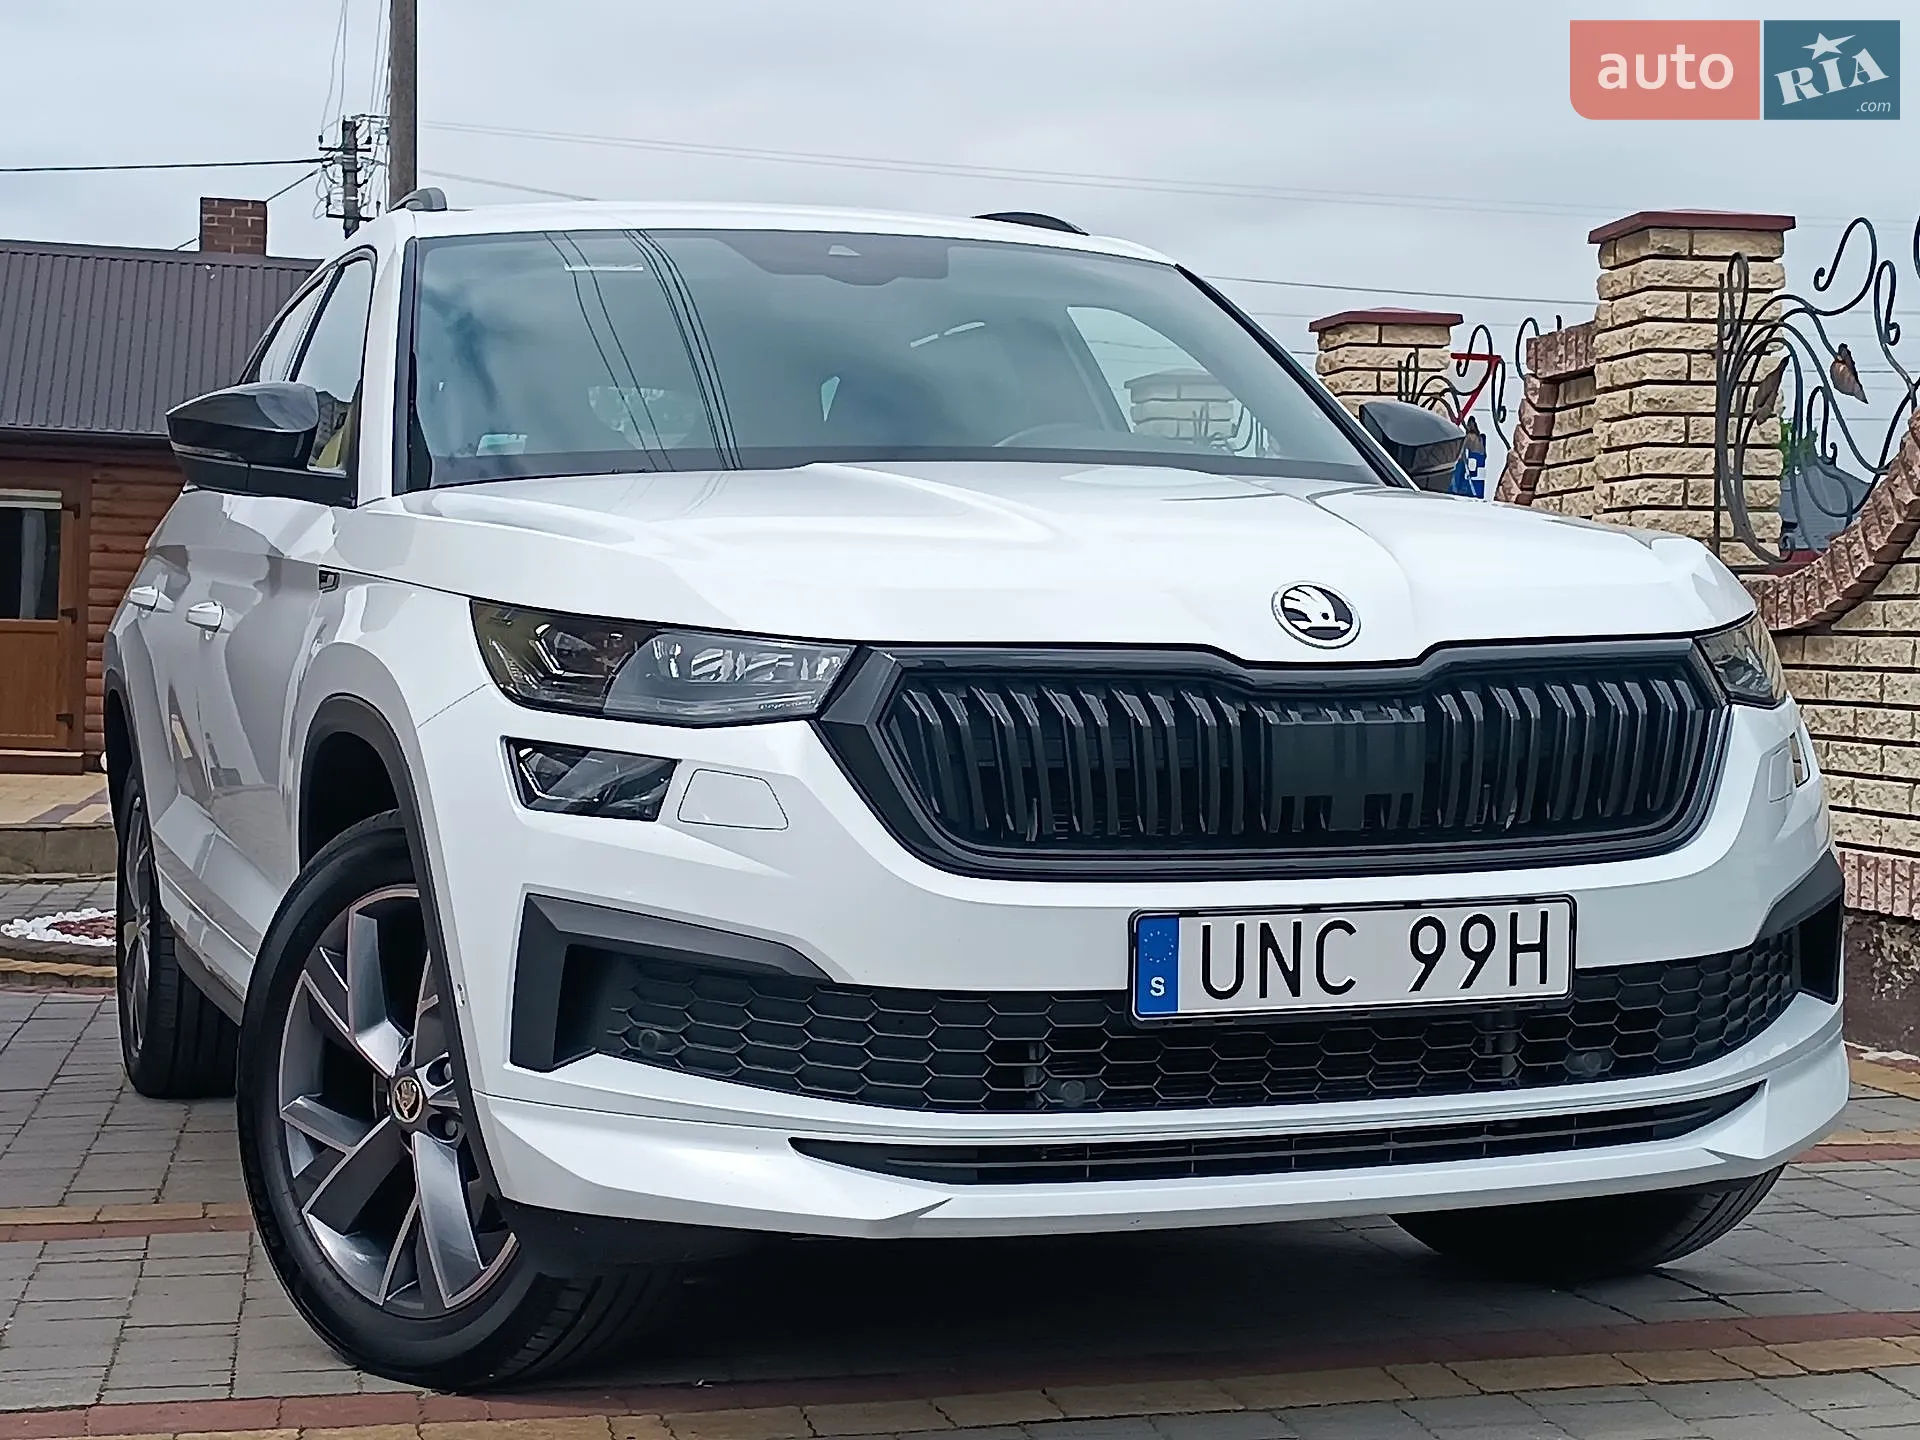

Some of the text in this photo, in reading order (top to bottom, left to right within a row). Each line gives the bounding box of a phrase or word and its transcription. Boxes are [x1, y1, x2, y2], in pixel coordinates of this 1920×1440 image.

[1201, 910, 1549, 1000] UNC 99H
[1150, 976, 1165, 997] S
